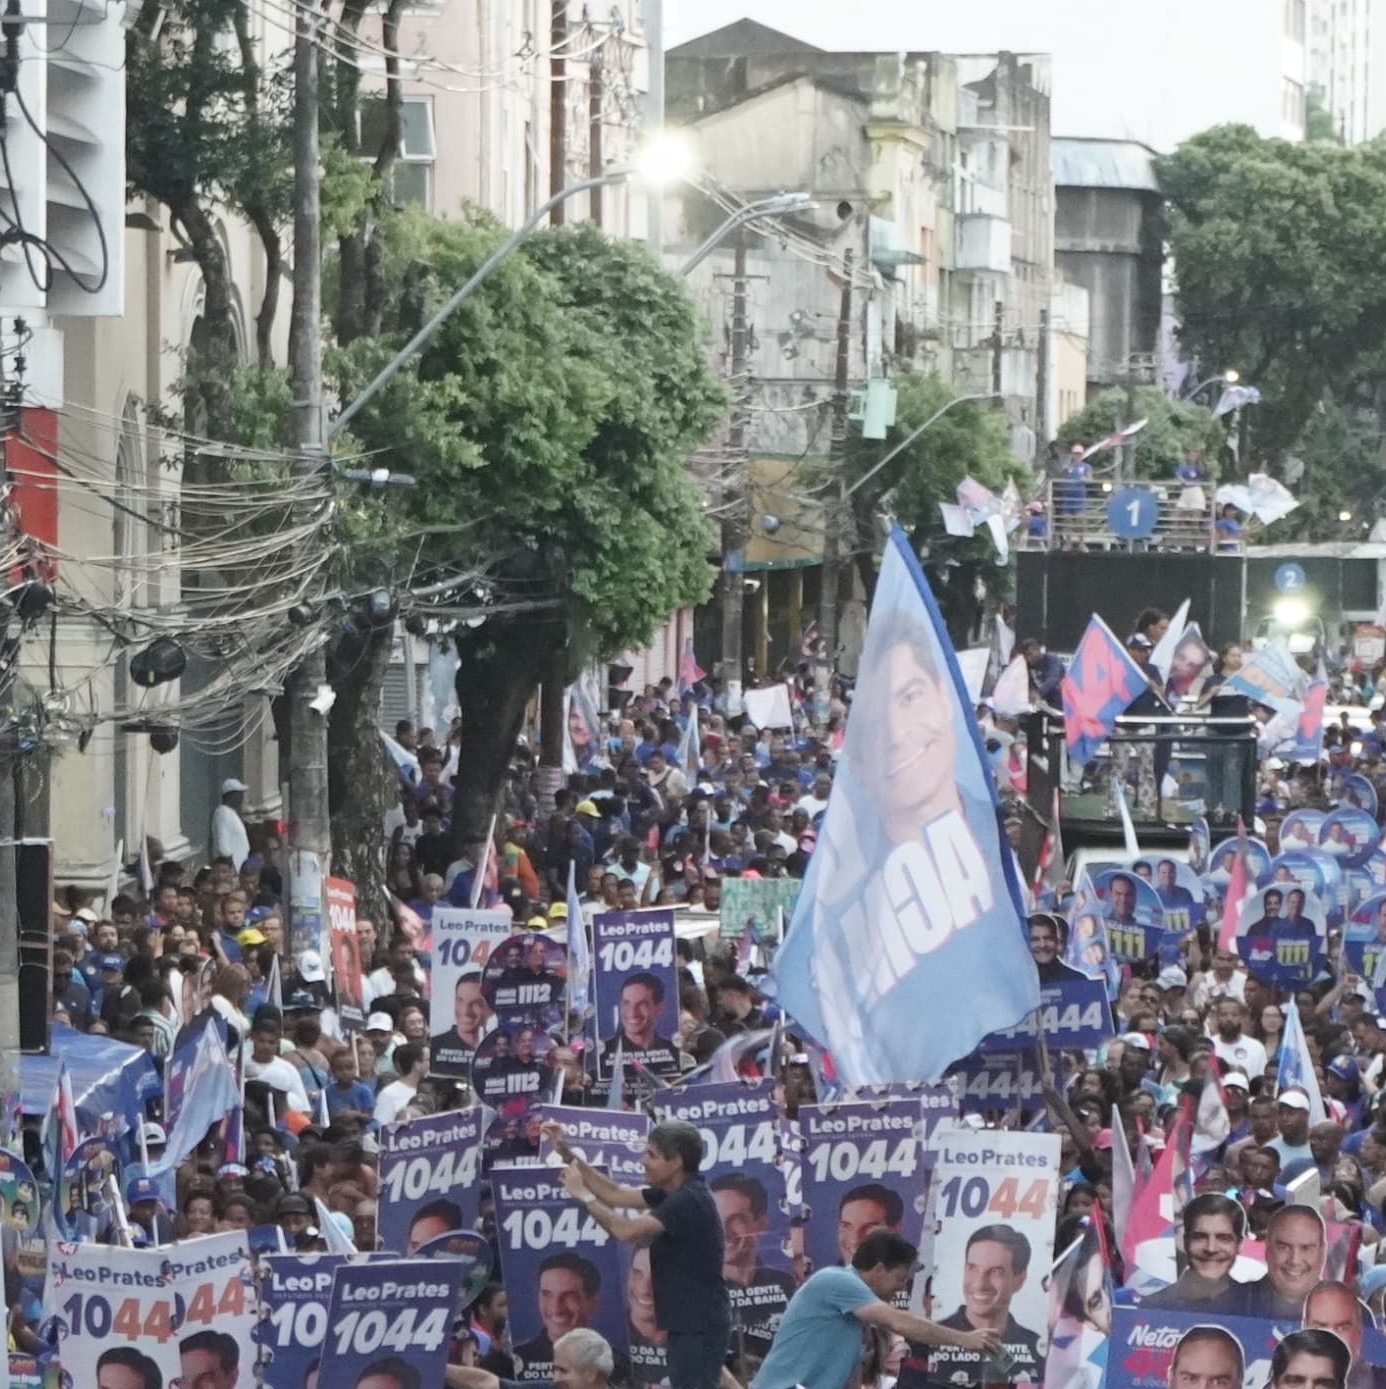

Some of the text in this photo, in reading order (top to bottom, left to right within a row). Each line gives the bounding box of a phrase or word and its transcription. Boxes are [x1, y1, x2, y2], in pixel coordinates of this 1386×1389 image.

[438, 938, 492, 967] 104
[599, 937, 674, 973] 1044
[383, 1145, 481, 1204] 1044
[809, 1137, 917, 1183] 1044
[941, 1176, 1050, 1220] 1044
[502, 1208, 610, 1251] 1044
[63, 1292, 171, 1344] 1044
[333, 1308, 450, 1355] 1044
